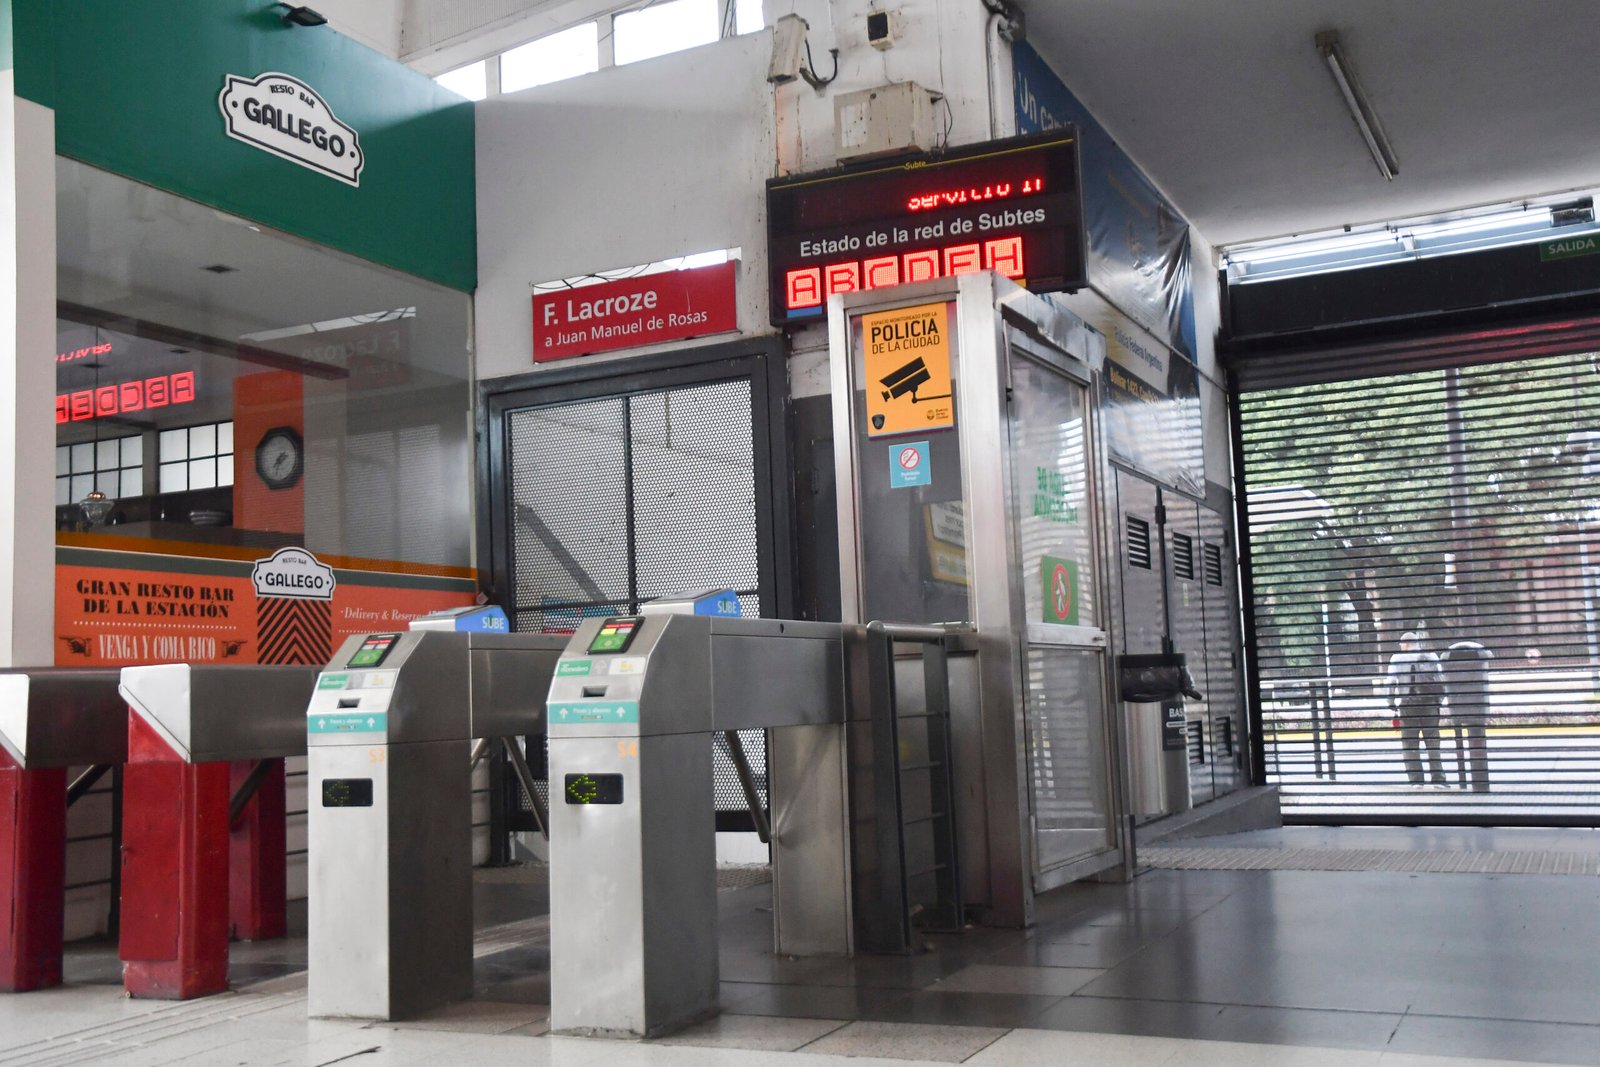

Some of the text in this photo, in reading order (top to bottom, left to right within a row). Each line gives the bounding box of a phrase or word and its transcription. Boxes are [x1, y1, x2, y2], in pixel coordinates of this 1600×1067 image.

[270, 84, 315, 109] RESTO BAR
[243, 97, 345, 158] GALLEGO
[904, 160, 927, 170] Subte
[800, 206, 1046, 257] Estado de la red de Subtes
[1549, 238, 1596, 254] SALIDA
[790, 273, 818, 304] A
[828, 267, 856, 294] B
[867, 260, 896, 289] C
[990, 240, 1020, 274] H
[544, 290, 658, 326] F. Lacroze
[545, 310, 708, 347] a Juan Manuel de Rosas
[871, 318, 889, 326] ESPACIO
[889, 313, 921, 323] MONITOREADO
[872, 318, 938, 343] POLICIA
[872, 335, 940, 355] DE LA CIUDAD
[76, 578, 234, 602] GRAN RESTO BAR
[265, 571, 324, 589] GALLEGO
[83, 598, 229, 618] DE LA ESTACIÓN
[344, 606, 380, 623] Delivery
[381, 609, 390, 620] &
[717, 599, 737, 614] SUBE
[482, 616, 504, 630] SUBE
[98, 634, 216, 661] VENGA Y COMA RICO
[1169, 707, 1184, 718] BAS
